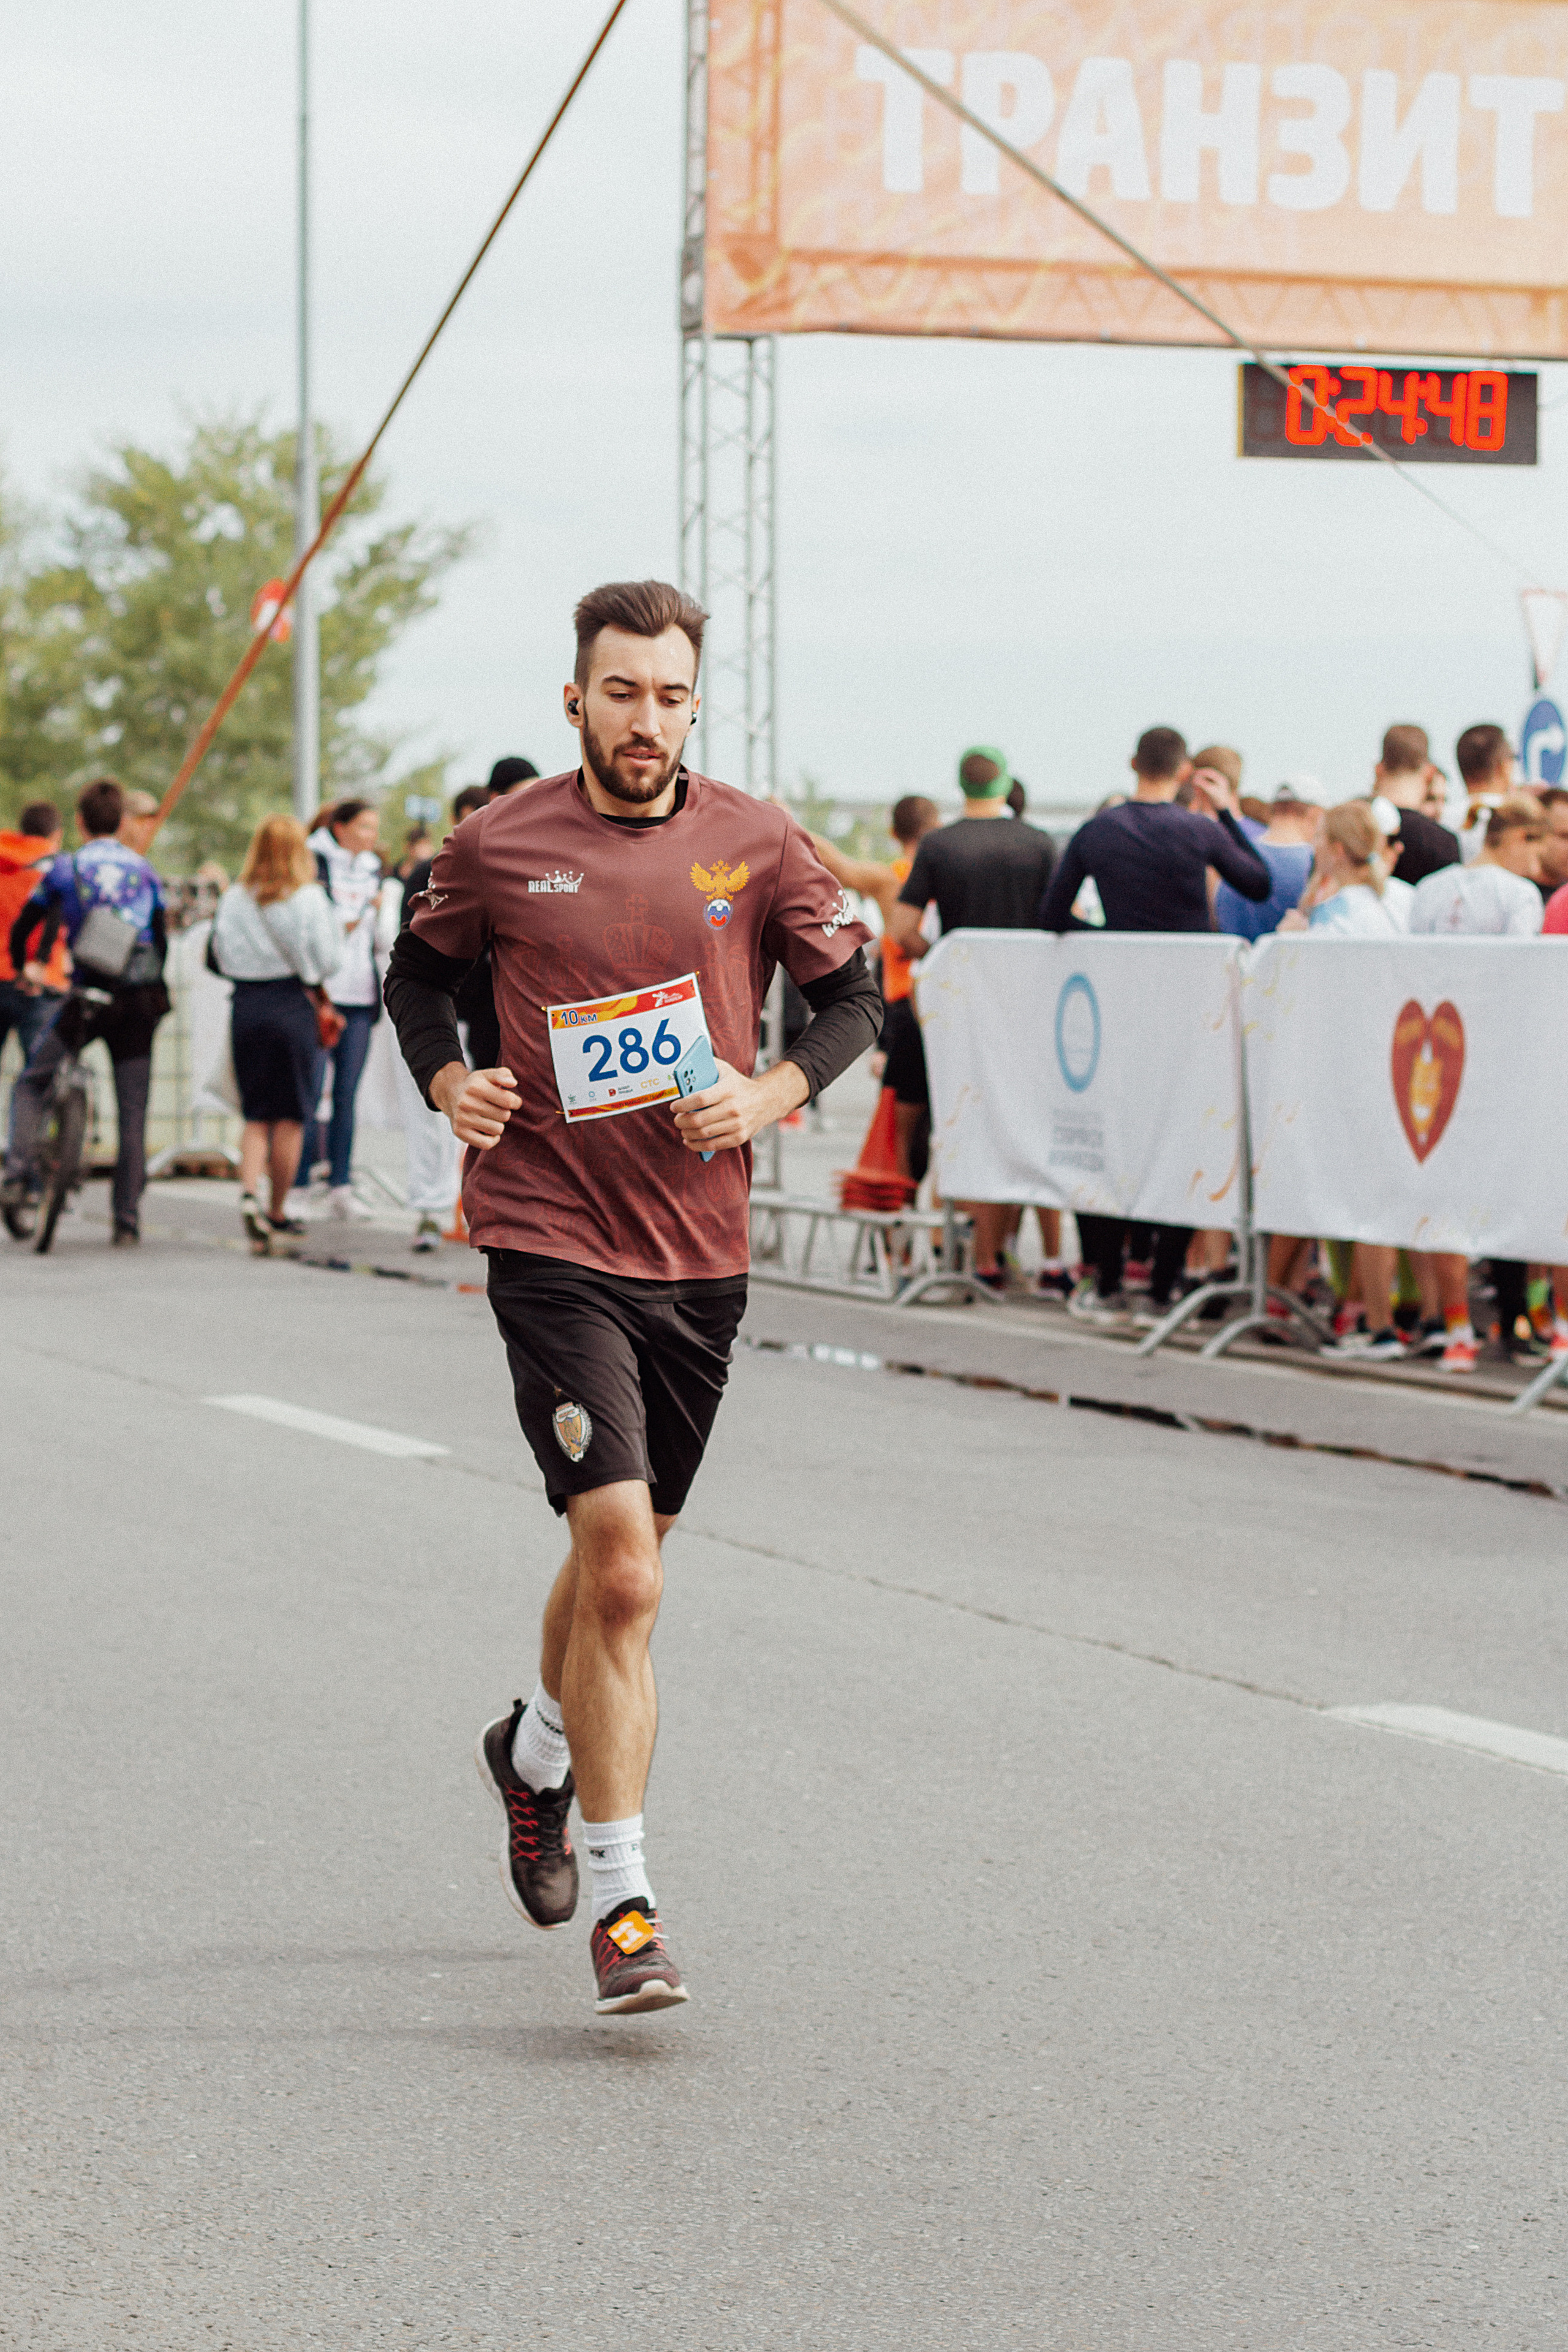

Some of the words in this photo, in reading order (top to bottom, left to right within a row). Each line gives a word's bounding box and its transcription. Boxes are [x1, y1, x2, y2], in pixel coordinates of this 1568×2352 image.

[853, 43, 1566, 219] ТРАНЗИТ
[1286, 364, 1509, 451] 0:24:48
[528, 880, 553, 892] REAL
[554, 883, 578, 893] SPORT
[560, 1009, 579, 1025] 10
[582, 1017, 682, 1082] 286
